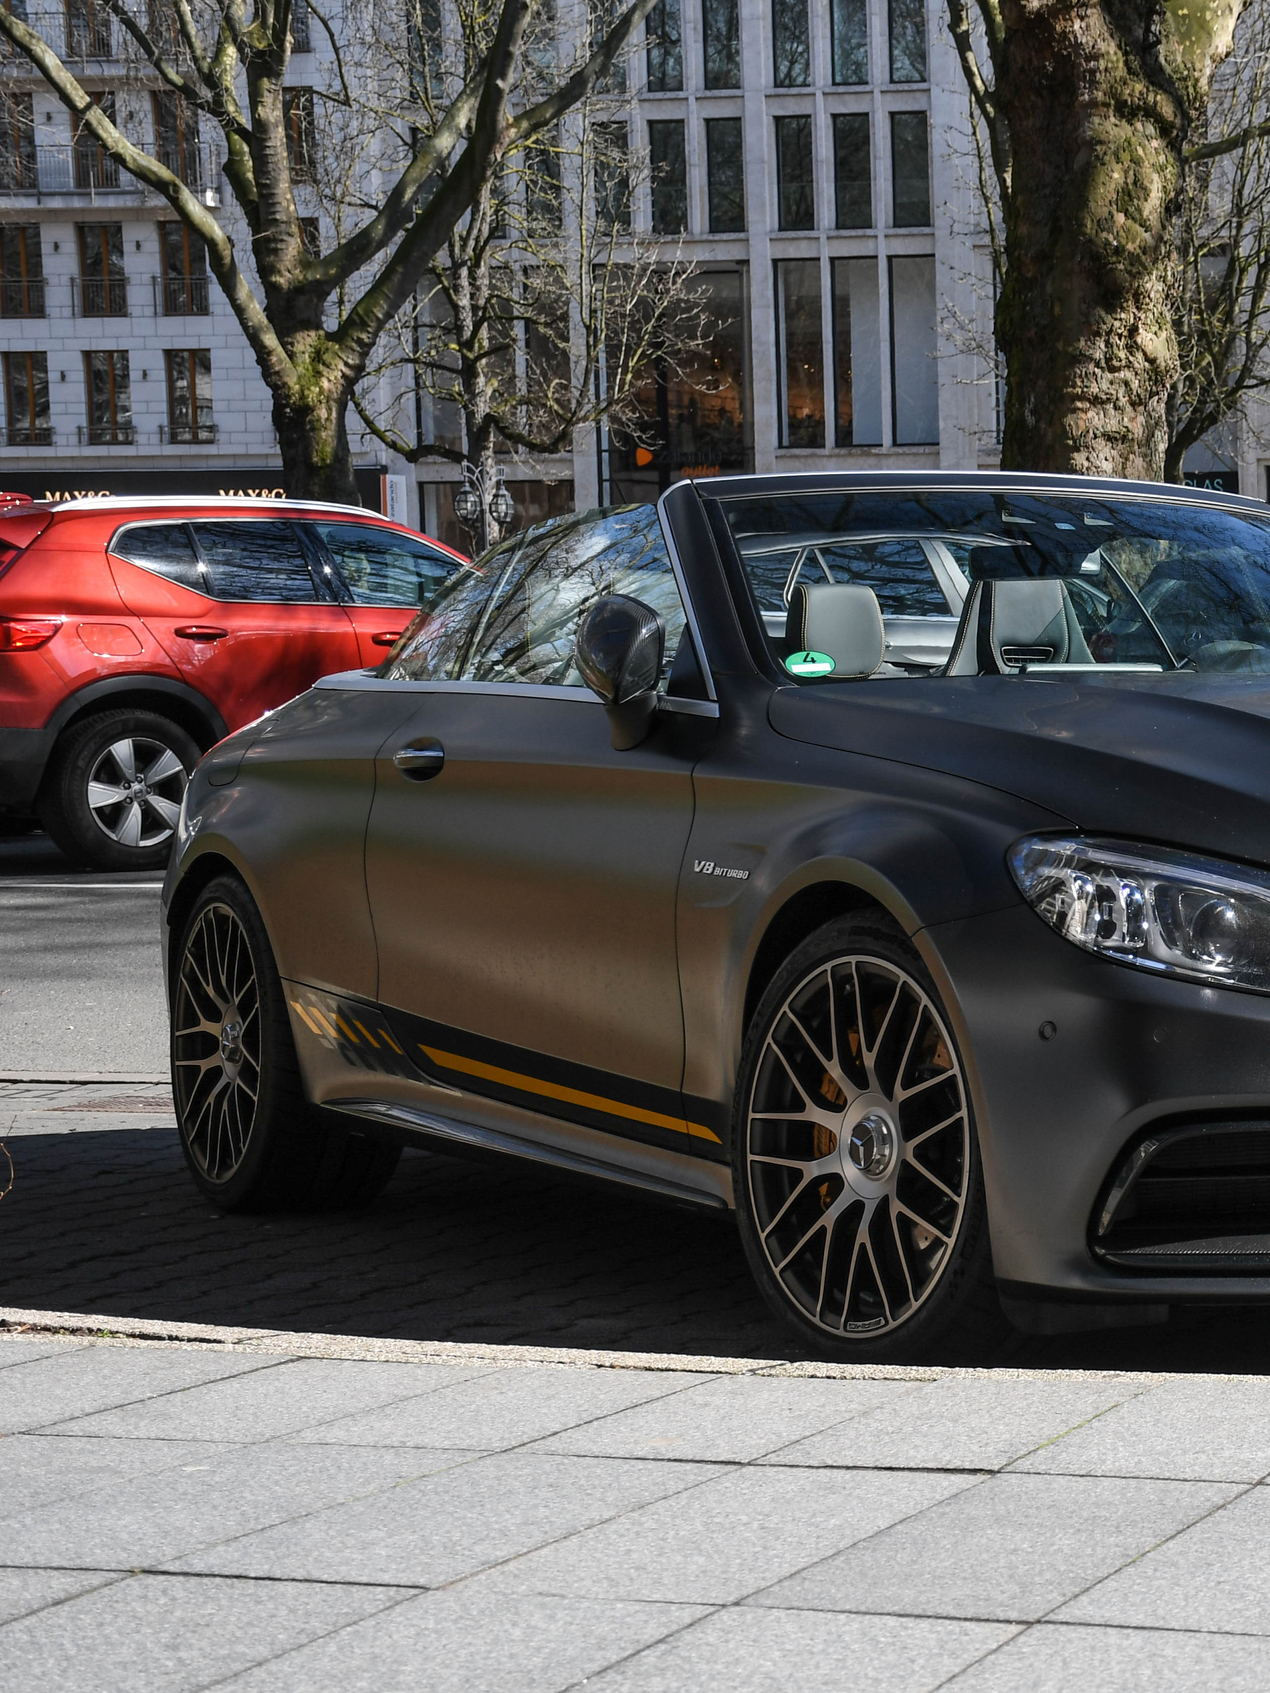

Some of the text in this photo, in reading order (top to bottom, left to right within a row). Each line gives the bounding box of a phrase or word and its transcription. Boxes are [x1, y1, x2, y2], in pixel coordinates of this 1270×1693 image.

[681, 464, 720, 477] outlet
[803, 652, 816, 663] 4
[693, 860, 749, 879] V8 BITURBO
